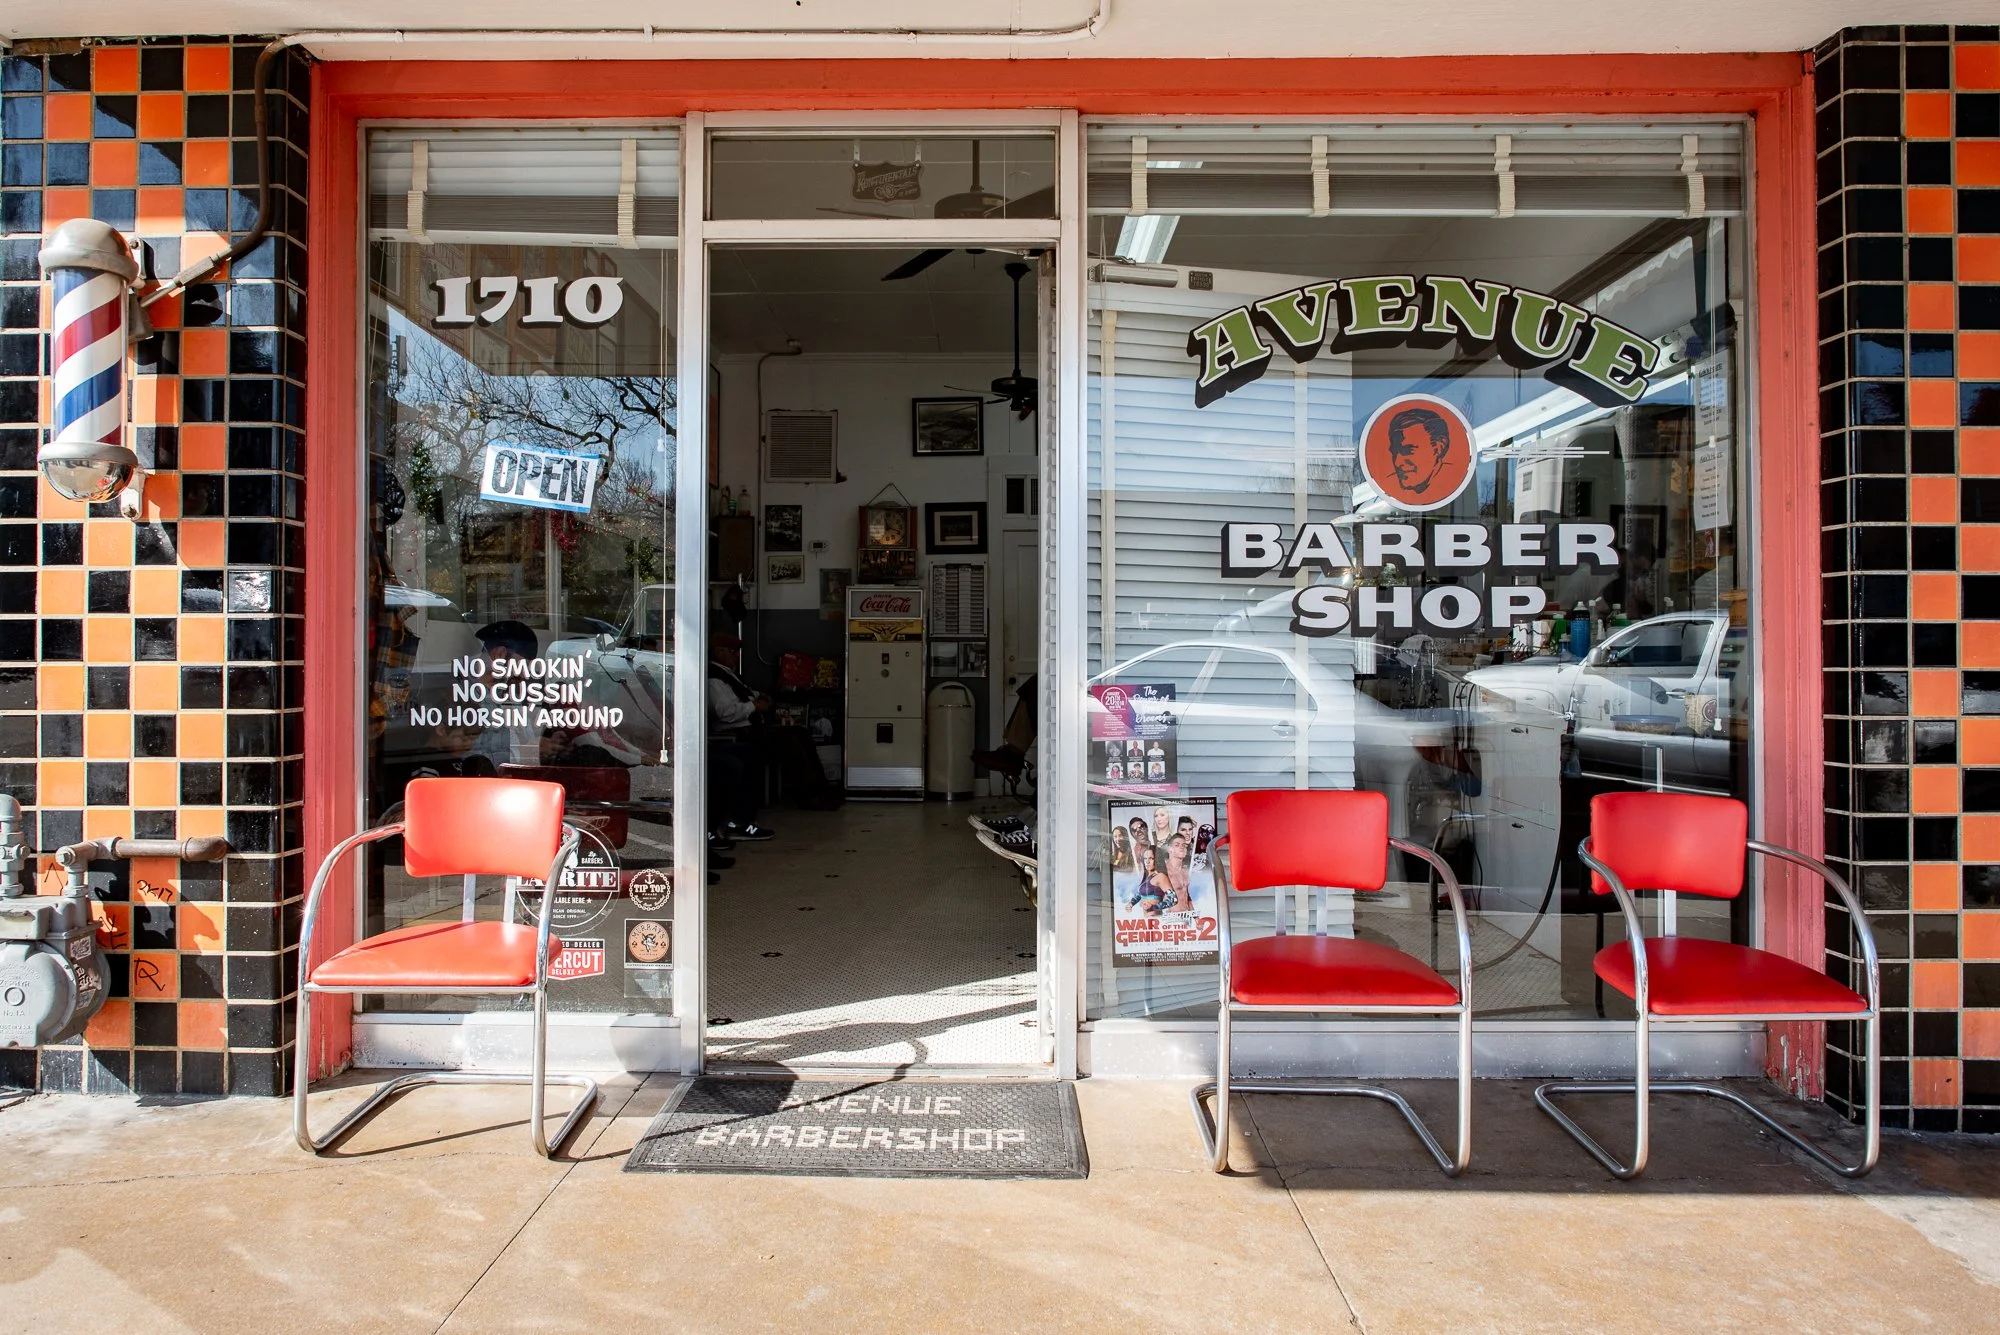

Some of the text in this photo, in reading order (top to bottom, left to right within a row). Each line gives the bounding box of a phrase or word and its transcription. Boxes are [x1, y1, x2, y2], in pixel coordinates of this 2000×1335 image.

[433, 275, 624, 327] 1710
[1189, 275, 1660, 407] AVENUE
[492, 449, 590, 503] OPEN
[1223, 523, 1619, 575] BARBER
[1293, 585, 1547, 634] SHOP
[453, 650, 592, 679] NO SMOKIN'
[452, 679, 593, 704] NO CUSSIN'
[1143, 686, 1158, 697] The
[410, 703, 623, 728] NO HORSIN' AROUND
[516, 871, 616, 888] LARITE
[634, 884, 666, 893] TIP TOP
[1116, 918, 1159, 931] WAR
[1196, 917, 1217, 941] 2
[1116, 930, 1197, 946] GENDERS
[554, 951, 602, 971] ERCUT
[778, 1095, 962, 1116] AVENUE
[695, 1125, 1025, 1151] BARBERSHOP
